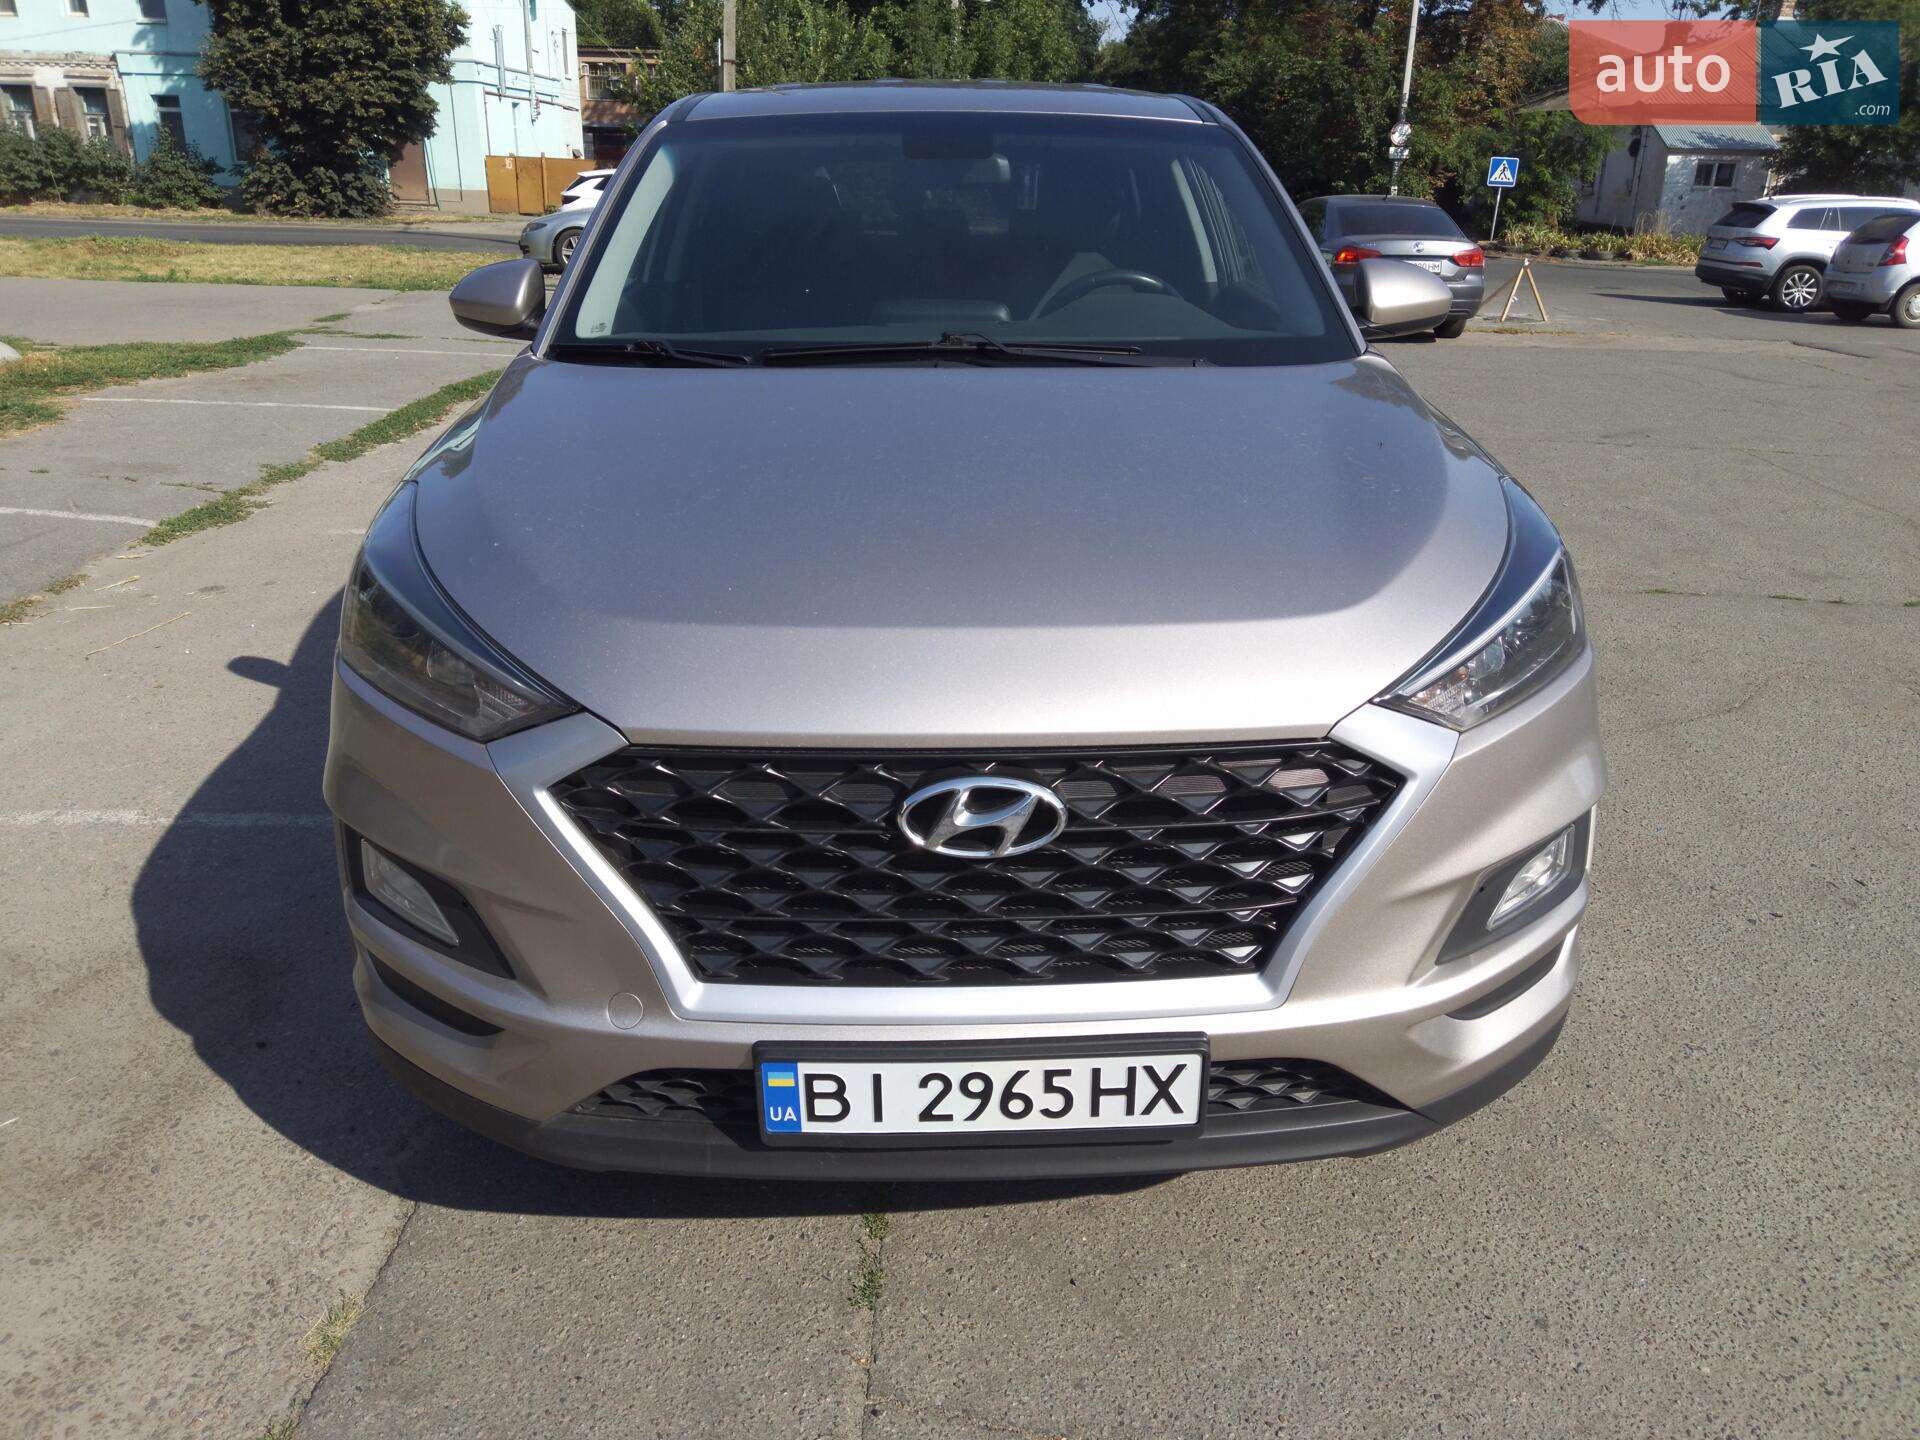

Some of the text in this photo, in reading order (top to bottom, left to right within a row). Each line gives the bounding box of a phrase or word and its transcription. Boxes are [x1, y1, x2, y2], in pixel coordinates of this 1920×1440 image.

[803, 1063, 1188, 1123] BI 2965 HX
[769, 1106, 798, 1122] UA
